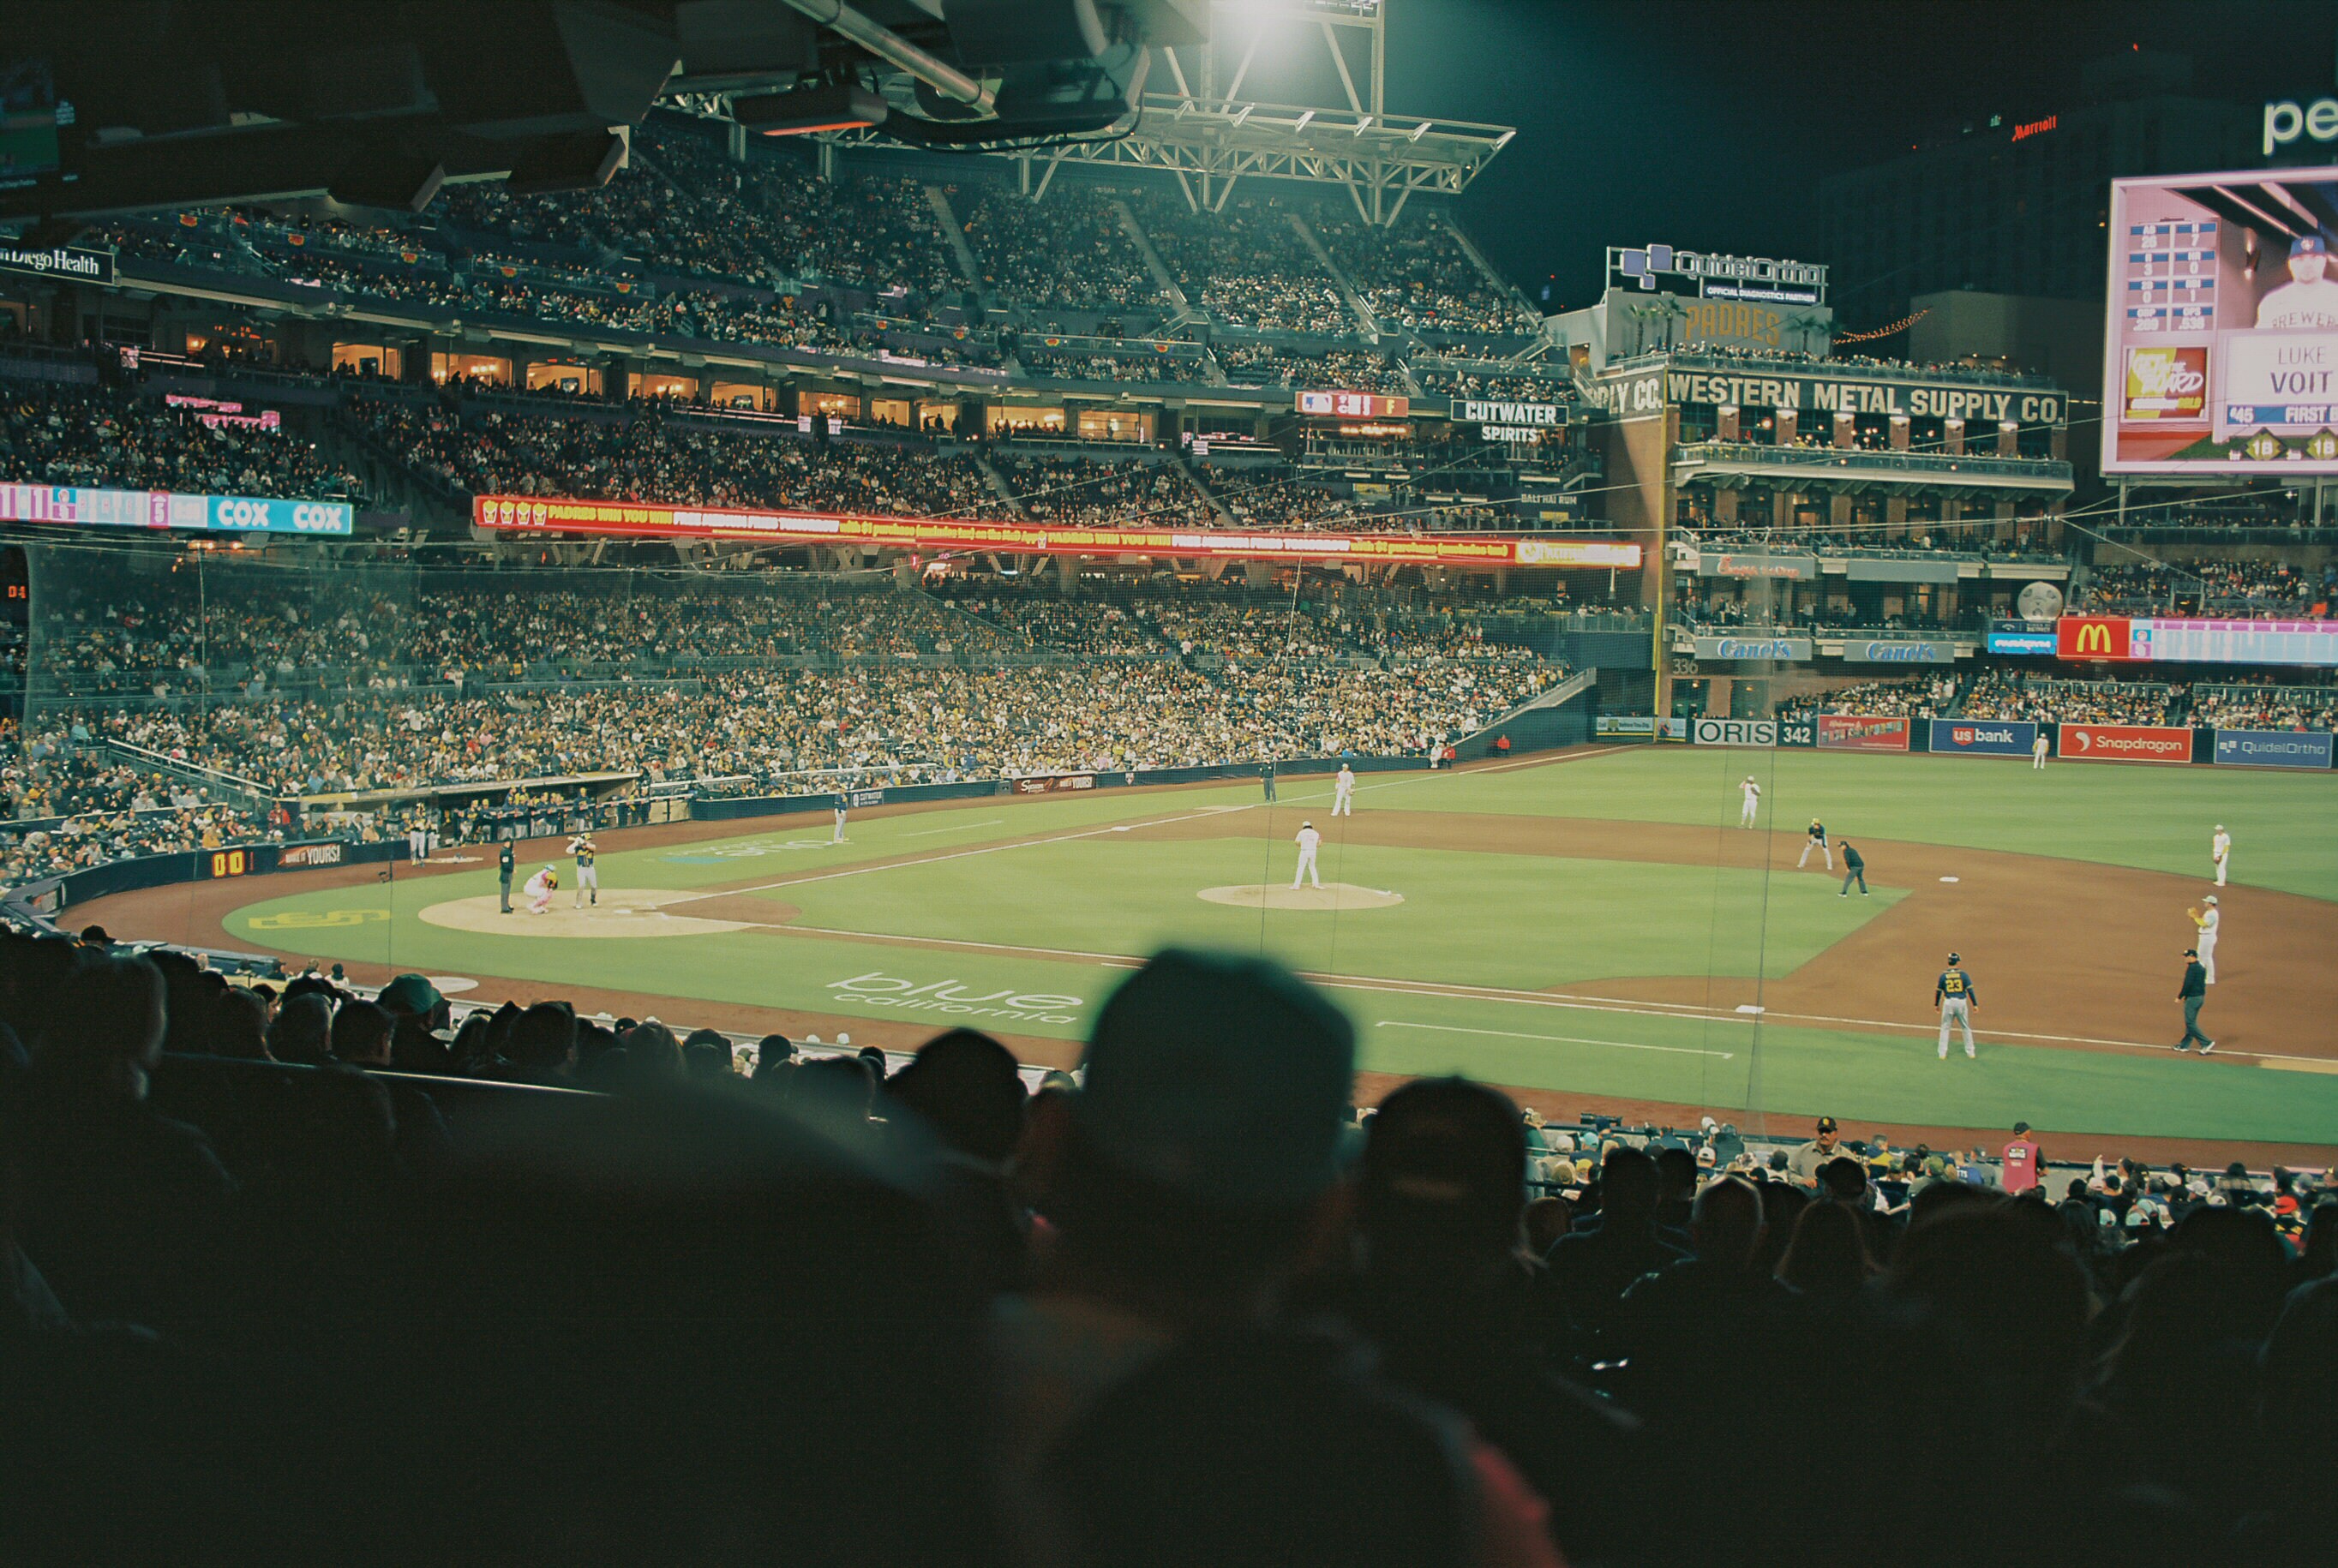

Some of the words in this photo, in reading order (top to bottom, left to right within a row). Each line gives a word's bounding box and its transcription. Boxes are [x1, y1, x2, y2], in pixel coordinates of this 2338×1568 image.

[2263, 101, 2338, 155] pe
[12, 248, 53, 271] Diego
[53, 248, 99, 275] Health
[1676, 250, 1820, 283] QuidelOrtho
[1706, 286, 1739, 296] OFFICIAL
[1685, 303, 1780, 345] PADRES
[2272, 311, 2338, 328] BREWER
[2278, 346, 2326, 364] LUKE
[2270, 370, 2333, 395] VOIT
[1634, 378, 1663, 410] CO.
[1668, 374, 1801, 409] WESTERN
[1813, 383, 1903, 415] METAL
[1910, 389, 2011, 421] SUPPLY
[2021, 396, 2065, 423] CO.
[1466, 401, 1557, 424] CUTWATER
[2286, 405, 2328, 423] FIRST
[1482, 426, 1538, 442] SPIRITS
[2252, 438, 2273, 456] 1B
[2314, 438, 2335, 456] 1B
[1559, 495, 1578, 505] RUM
[154, 502, 165, 523] 5
[218, 500, 269, 526] COX
[293, 504, 342, 530] COX
[548, 505, 596, 521] PADRES
[597, 507, 622, 522] WIN
[623, 509, 648, 523] YOU
[649, 510, 673, 524] WIN
[1047, 532, 1094, 543] PADRES
[1094, 533, 1119, 545] WIN
[1120, 533, 1147, 546] YOU
[1147, 534, 1172, 546] WIN
[1672, 658, 1699, 674] 336
[1699, 721, 1774, 744] ORIS
[1783, 726, 1811, 744] 342
[1953, 730, 1972, 742] us
[1975, 728, 2014, 744] bank
[2096, 735, 2183, 754] Snapdragon
[2241, 740, 2326, 755] QuidelOrtho
[307, 845, 340, 865] YOURS!
[828, 972, 1083, 1010] blue
[1945, 979, 1963, 992] 23
[833, 993, 1077, 1025] california
